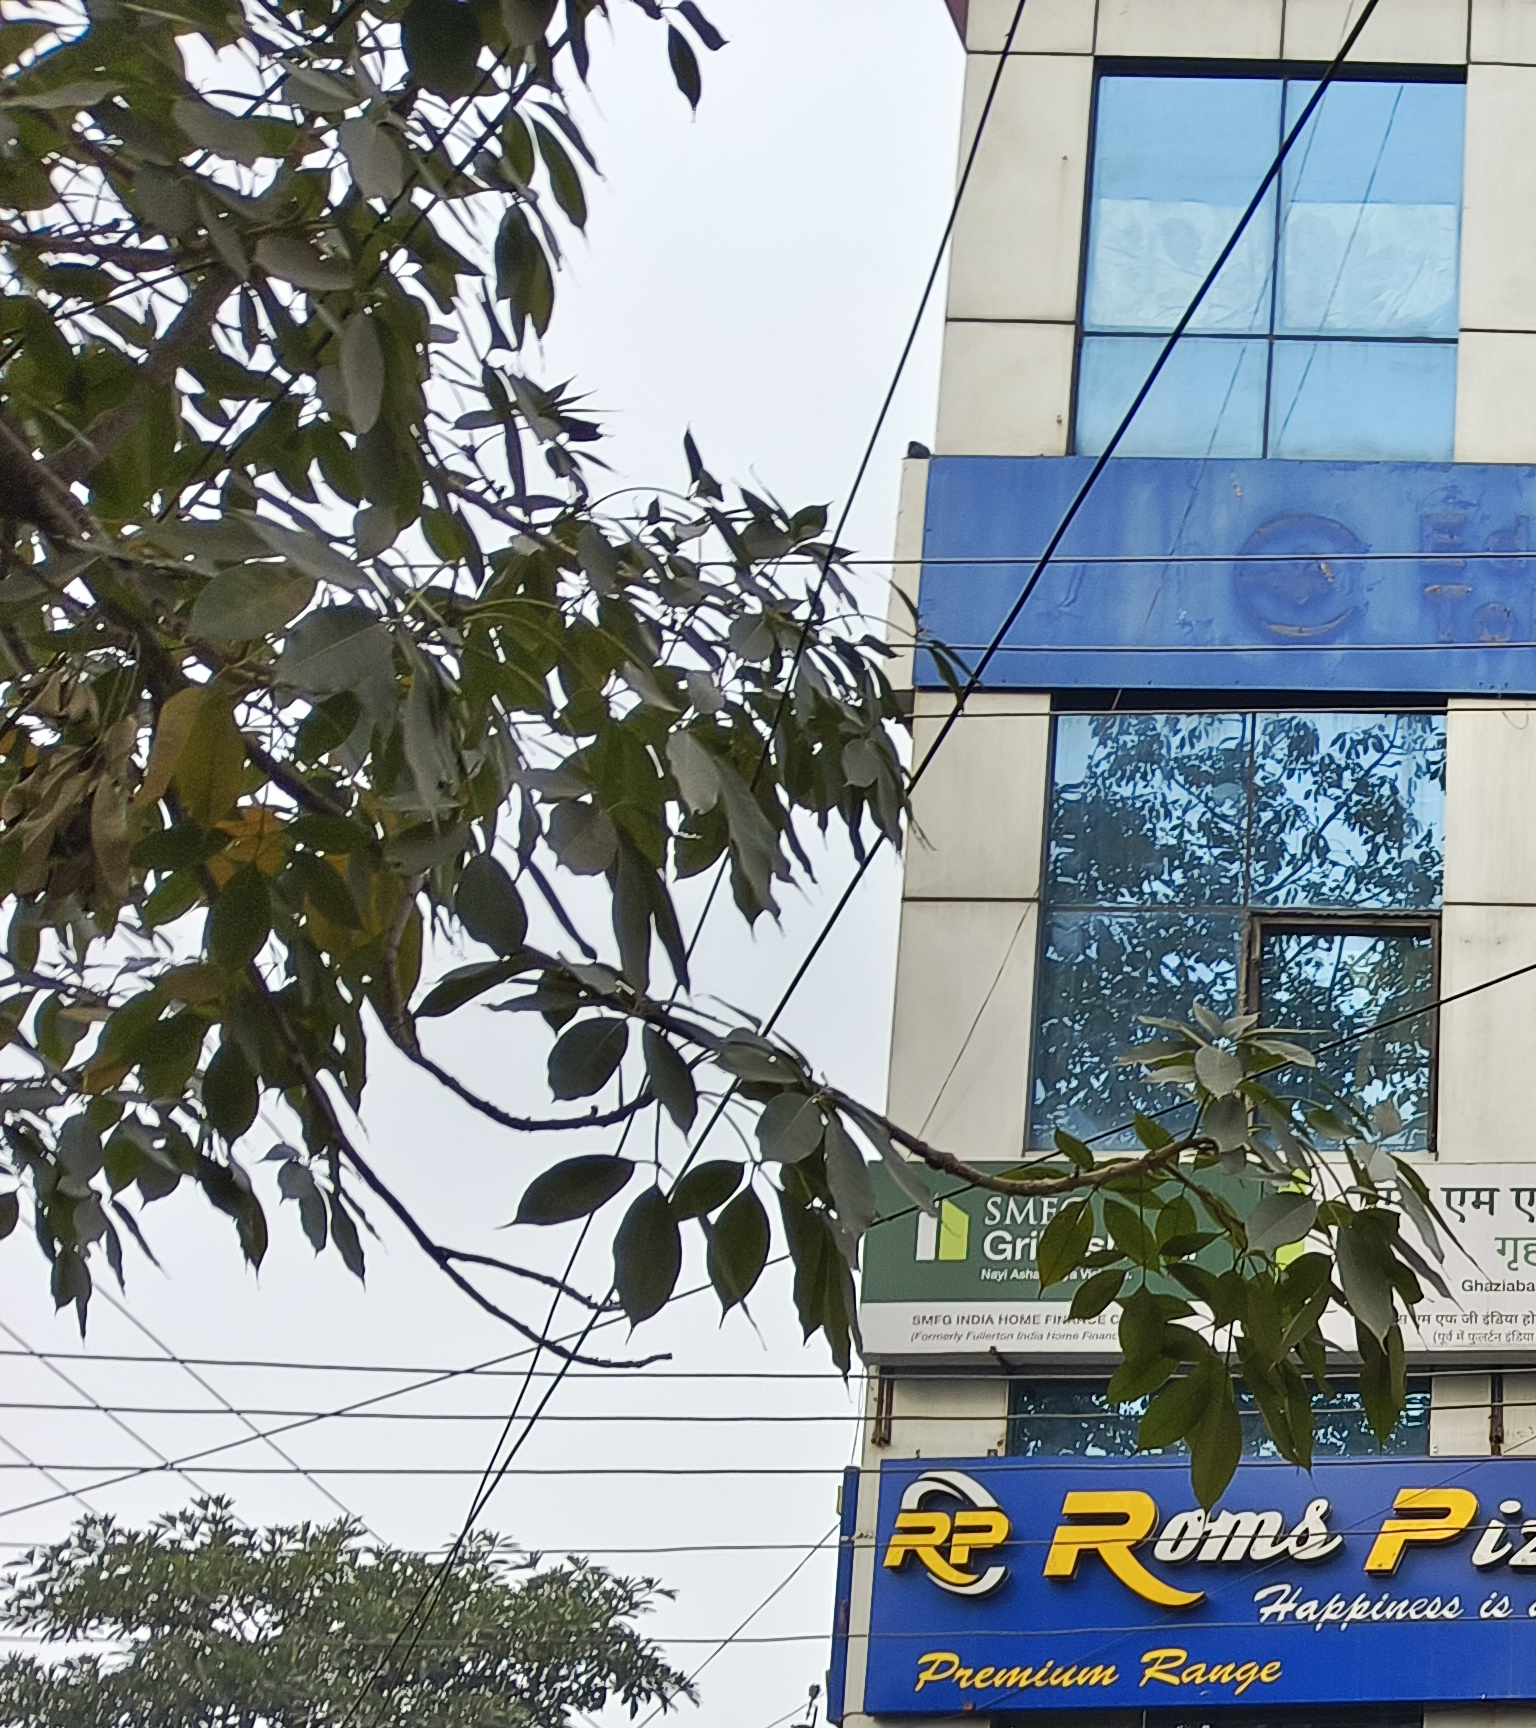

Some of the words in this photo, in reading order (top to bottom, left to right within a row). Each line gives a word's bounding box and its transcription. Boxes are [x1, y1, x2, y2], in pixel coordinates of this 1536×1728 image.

[1440, 1187, 1500, 1223] एम
[956, 1314, 994, 1326] INDIA
[998, 1313, 1042, 1326] HOME
[1082, 1329, 1118, 1341] Financ
[1042, 1490, 1343, 1608] Roms
[1252, 1582, 1466, 1631] Happiness
[1478, 1591, 1514, 1619] is
[915, 1650, 1120, 1693] Premium
[1139, 1646, 1284, 1695] Range
